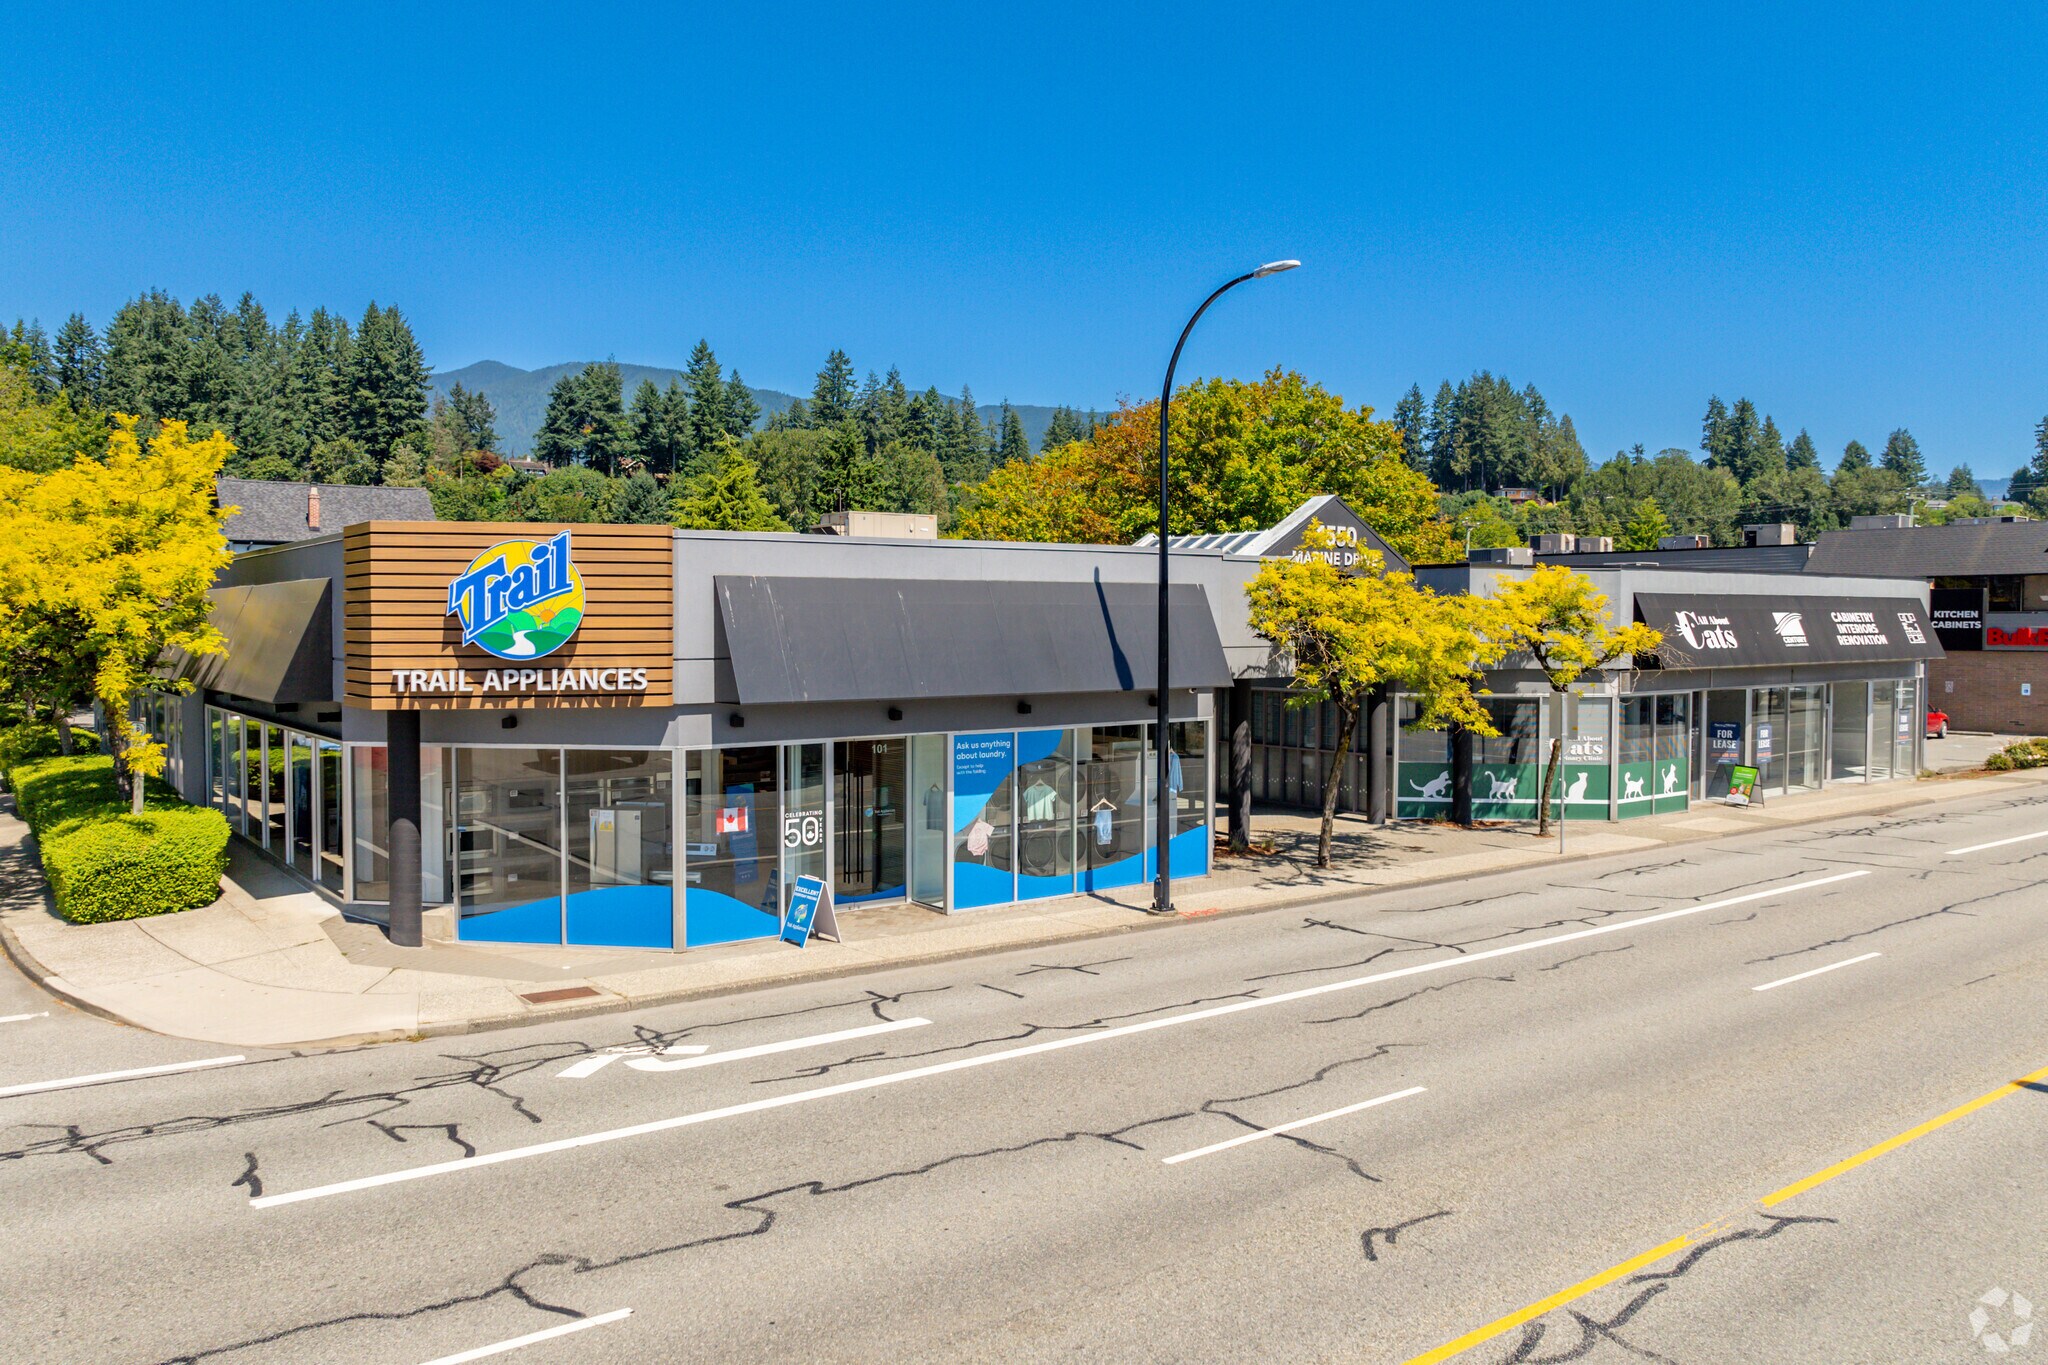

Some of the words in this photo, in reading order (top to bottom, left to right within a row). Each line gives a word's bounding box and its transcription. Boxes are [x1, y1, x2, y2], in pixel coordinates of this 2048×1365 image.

[1291, 550, 1341, 566] MANE
[1344, 552, 1378, 567] DRV
[448, 530, 575, 643] Trail
[1830, 611, 1875, 623] CABINETRY
[1933, 610, 1979, 619] KITCHEN
[1697, 615, 1709, 625] All
[1708, 615, 1730, 625] About
[1931, 620, 1982, 629] CABINETS
[1675, 611, 1738, 650] Cats
[1835, 622, 1879, 634] INTERIORS
[1837, 633, 1888, 646] RENOVATION
[392, 669, 473, 693] TRAIL
[483, 668, 648, 692] APPLIANCES
[1716, 729, 1733, 739] FOR
[1759, 729, 1769, 738] FOR
[871, 744, 888, 754] 101
[956, 742, 970, 750] Ask
[980, 740, 1011, 749] anything
[1712, 739, 1737, 749] LEASE
[956, 752, 978, 760] about
[979, 750, 1007, 759] laundry.
[784, 809, 823, 819] CELEBRATING
[784, 816, 819, 848] 50
